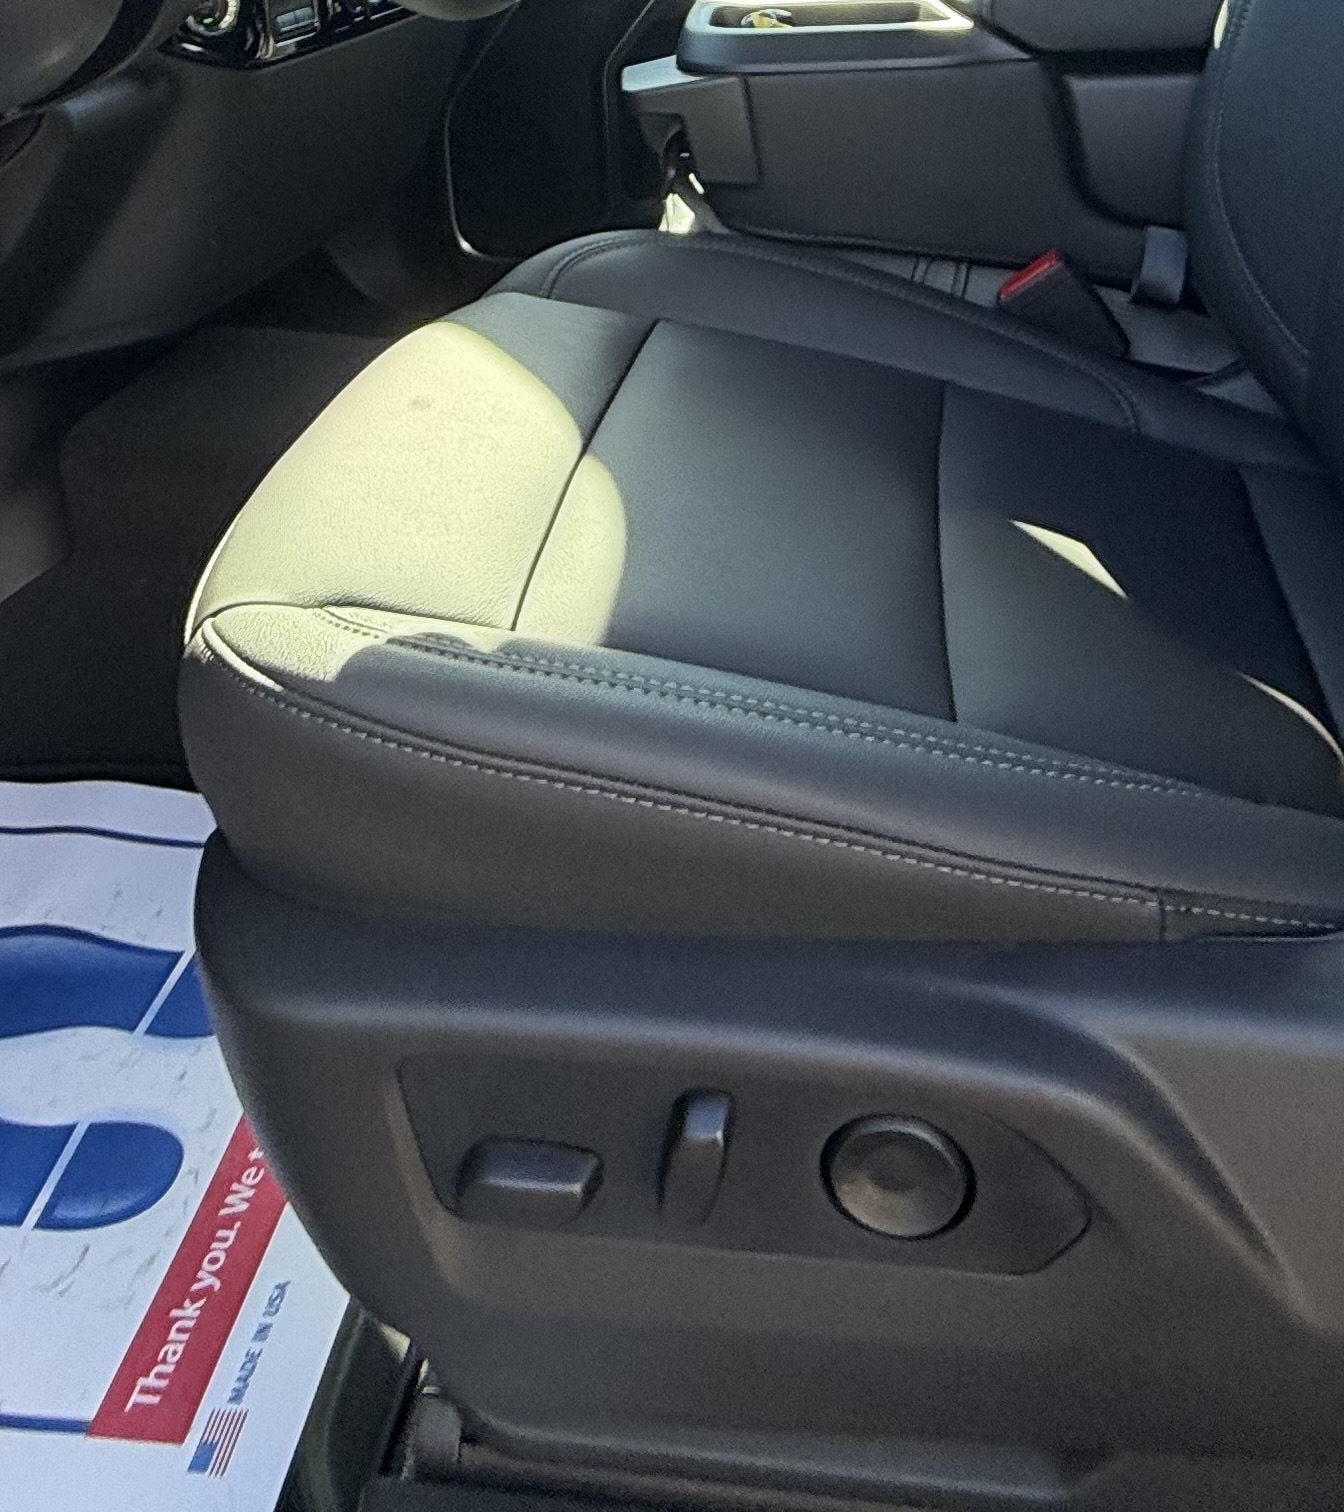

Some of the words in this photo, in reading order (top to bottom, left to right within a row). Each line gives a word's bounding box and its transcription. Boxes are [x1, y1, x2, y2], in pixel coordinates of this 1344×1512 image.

[124, 1295, 207, 1414] Thank
[190, 1221, 242, 1292] you.
[218, 1165, 265, 1217] We
[262, 1279, 291, 1318] USA
[251, 1322, 274, 1343] IN
[226, 1346, 264, 1406] MADE
